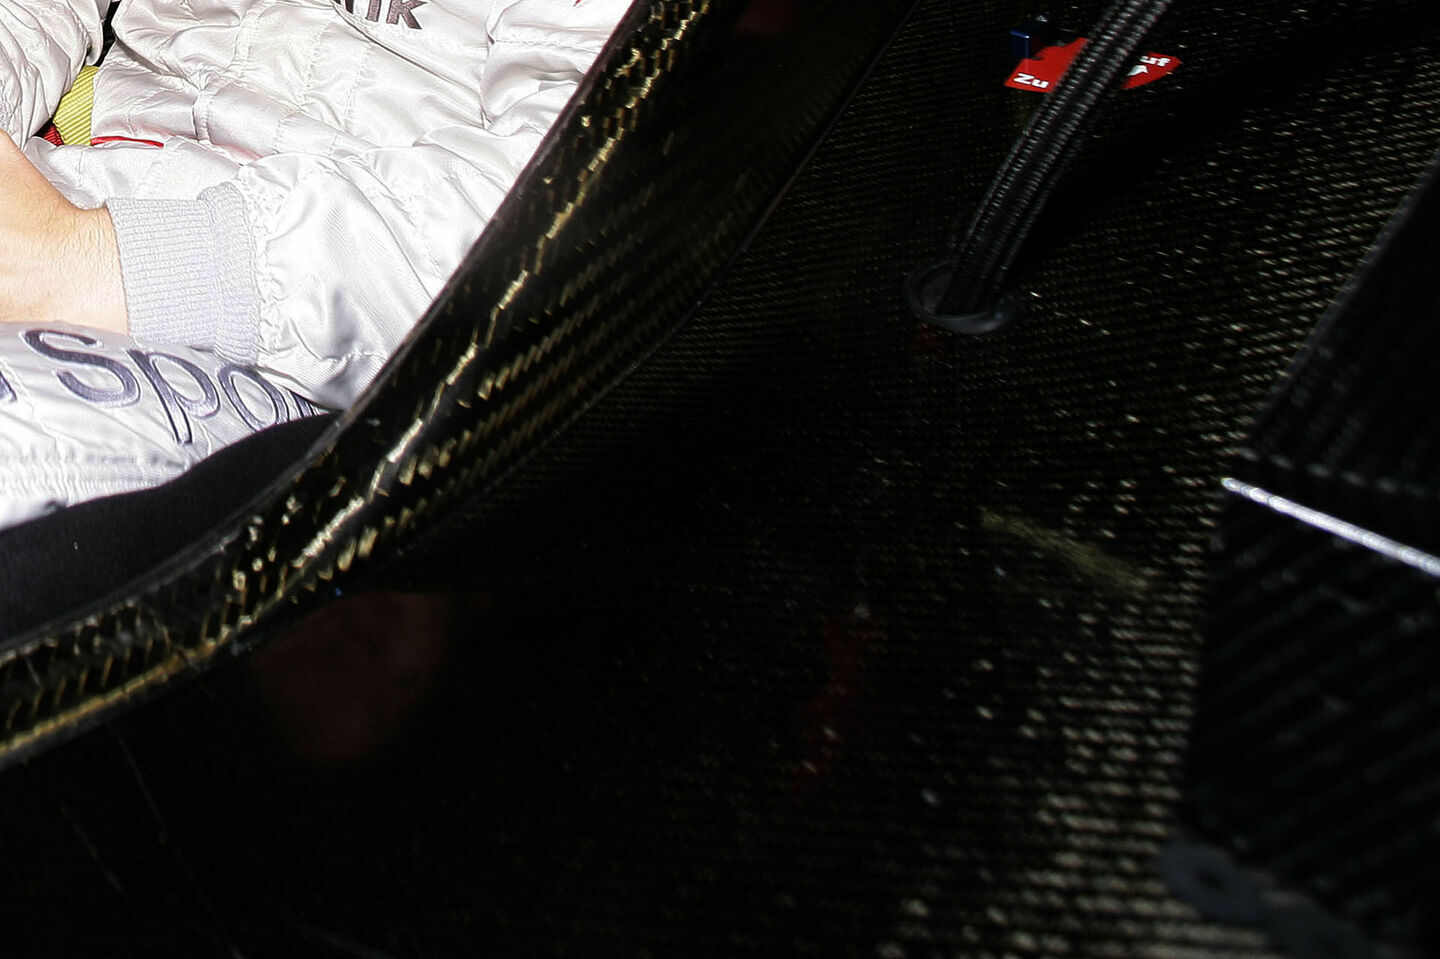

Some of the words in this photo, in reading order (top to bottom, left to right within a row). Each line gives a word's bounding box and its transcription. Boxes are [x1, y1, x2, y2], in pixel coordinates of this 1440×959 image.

[1140, 55, 1171, 67] uf
[1013, 72, 1050, 89] Zu
[21, 328, 320, 446] Spo
